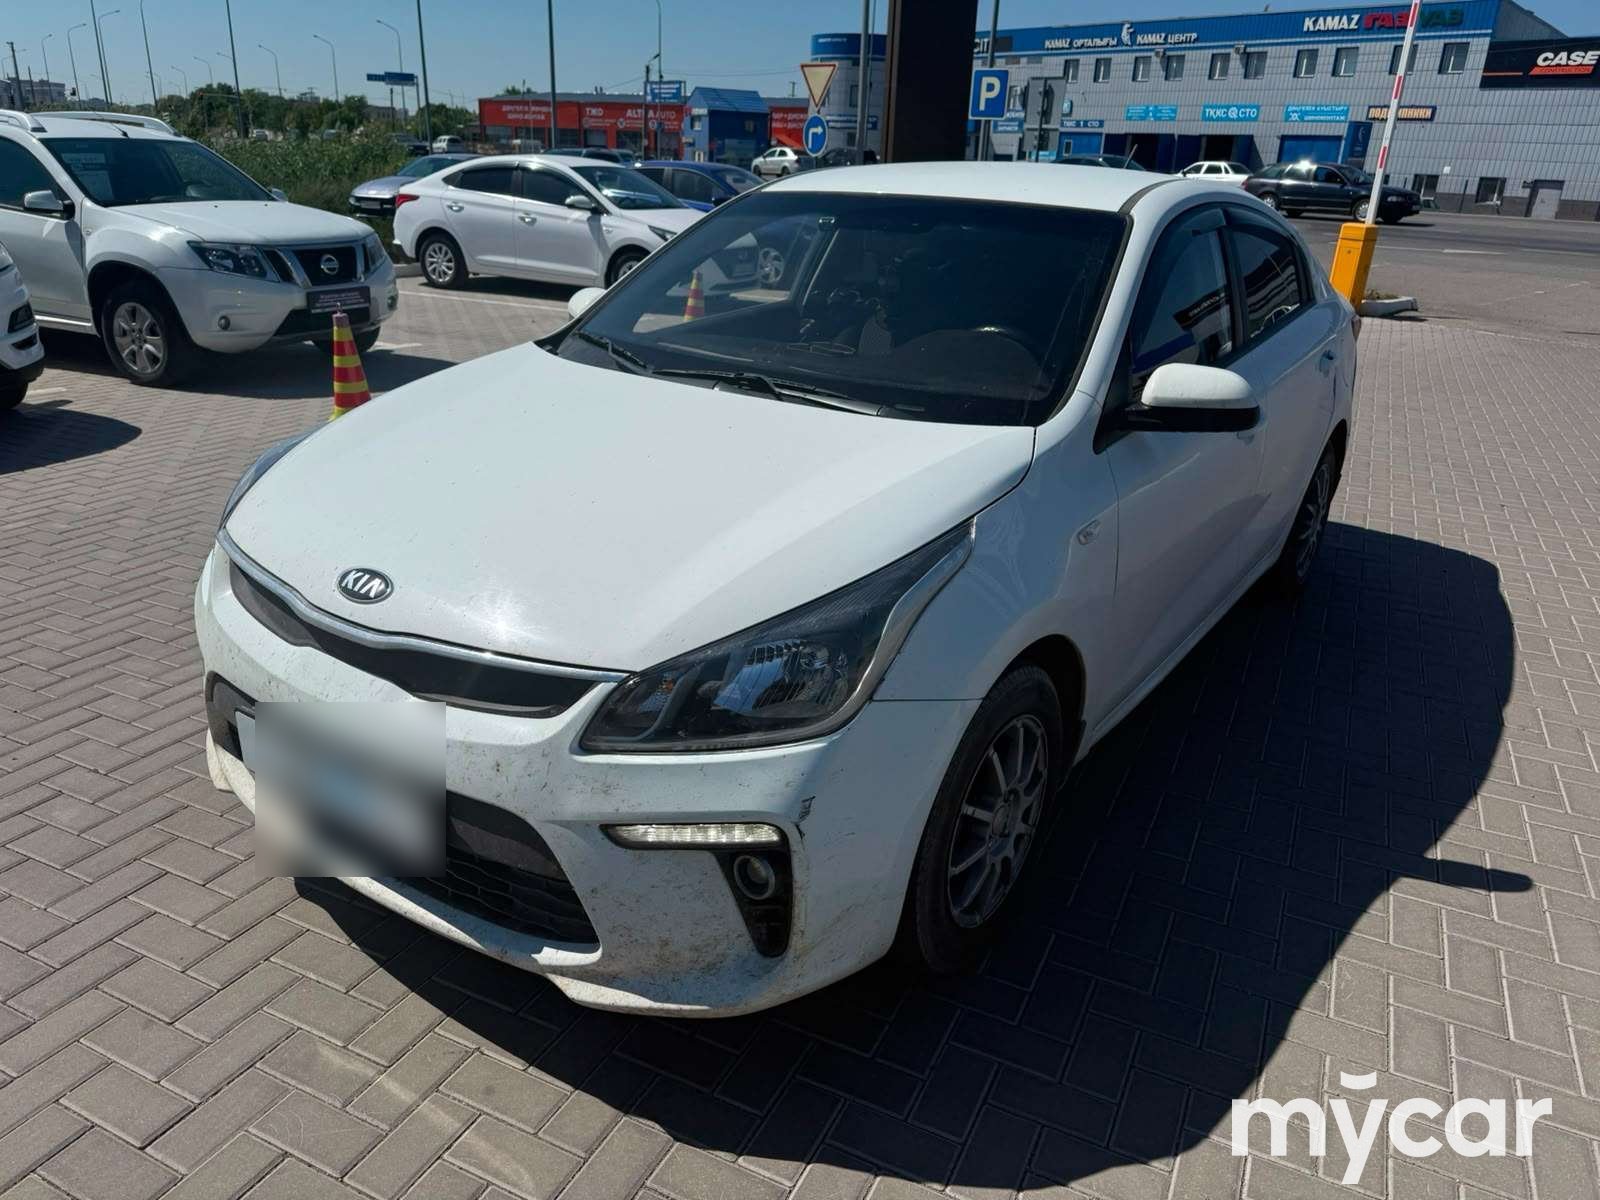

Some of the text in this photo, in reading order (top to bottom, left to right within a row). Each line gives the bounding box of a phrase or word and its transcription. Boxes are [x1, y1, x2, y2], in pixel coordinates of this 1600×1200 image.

[1303, 14, 1360, 32] KAMAZ
[1136, 33, 1198, 45] KAMAZ ЦЕНТР
[1536, 51, 1600, 67] CASE
[979, 76, 1001, 111] P
[626, 108, 655, 118] ALTA
[1368, 107, 1432, 120] ПОДИПНИКИ
